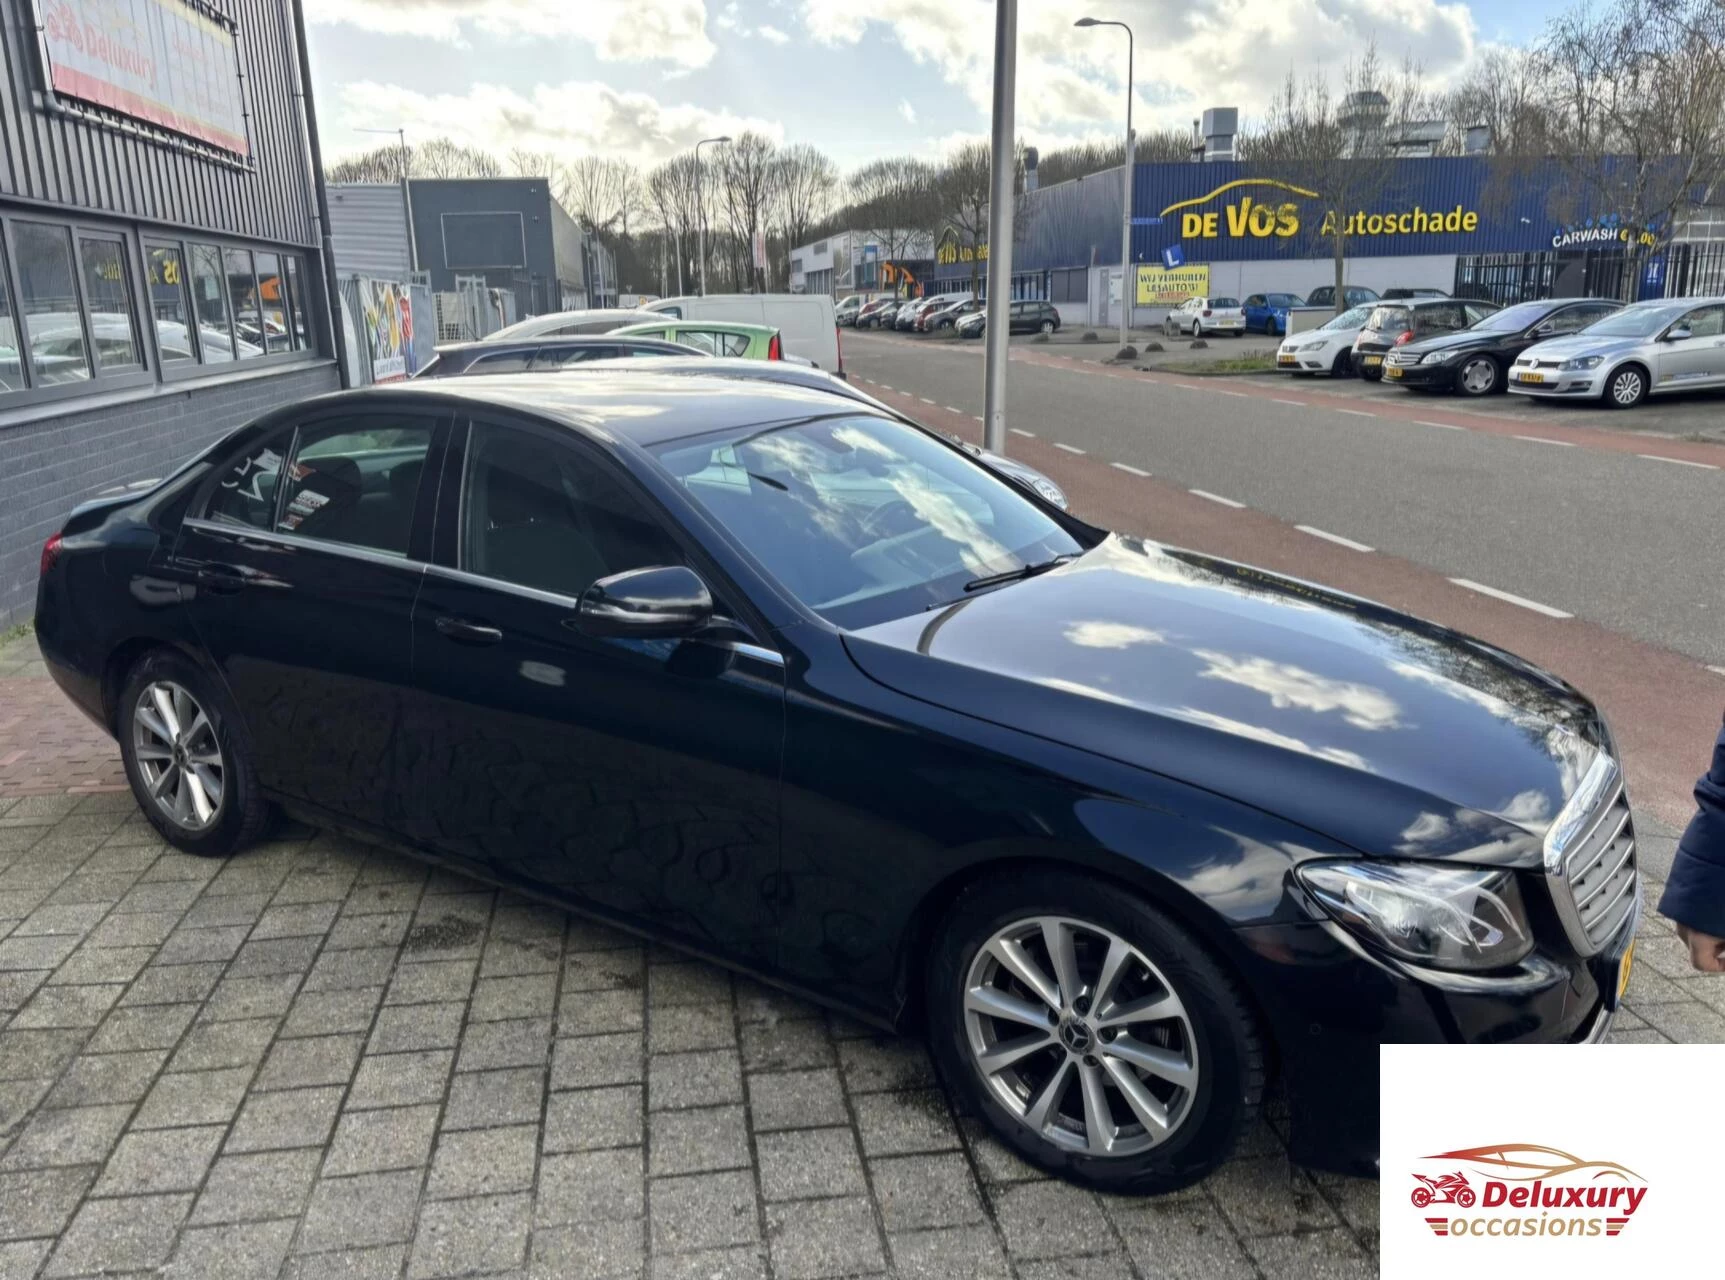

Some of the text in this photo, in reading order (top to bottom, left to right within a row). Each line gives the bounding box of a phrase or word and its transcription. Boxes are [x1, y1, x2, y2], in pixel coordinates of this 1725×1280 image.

[1182, 197, 1478, 238] DE VOS Autoschade
[1552, 227, 1656, 248] CARWASH €.00
